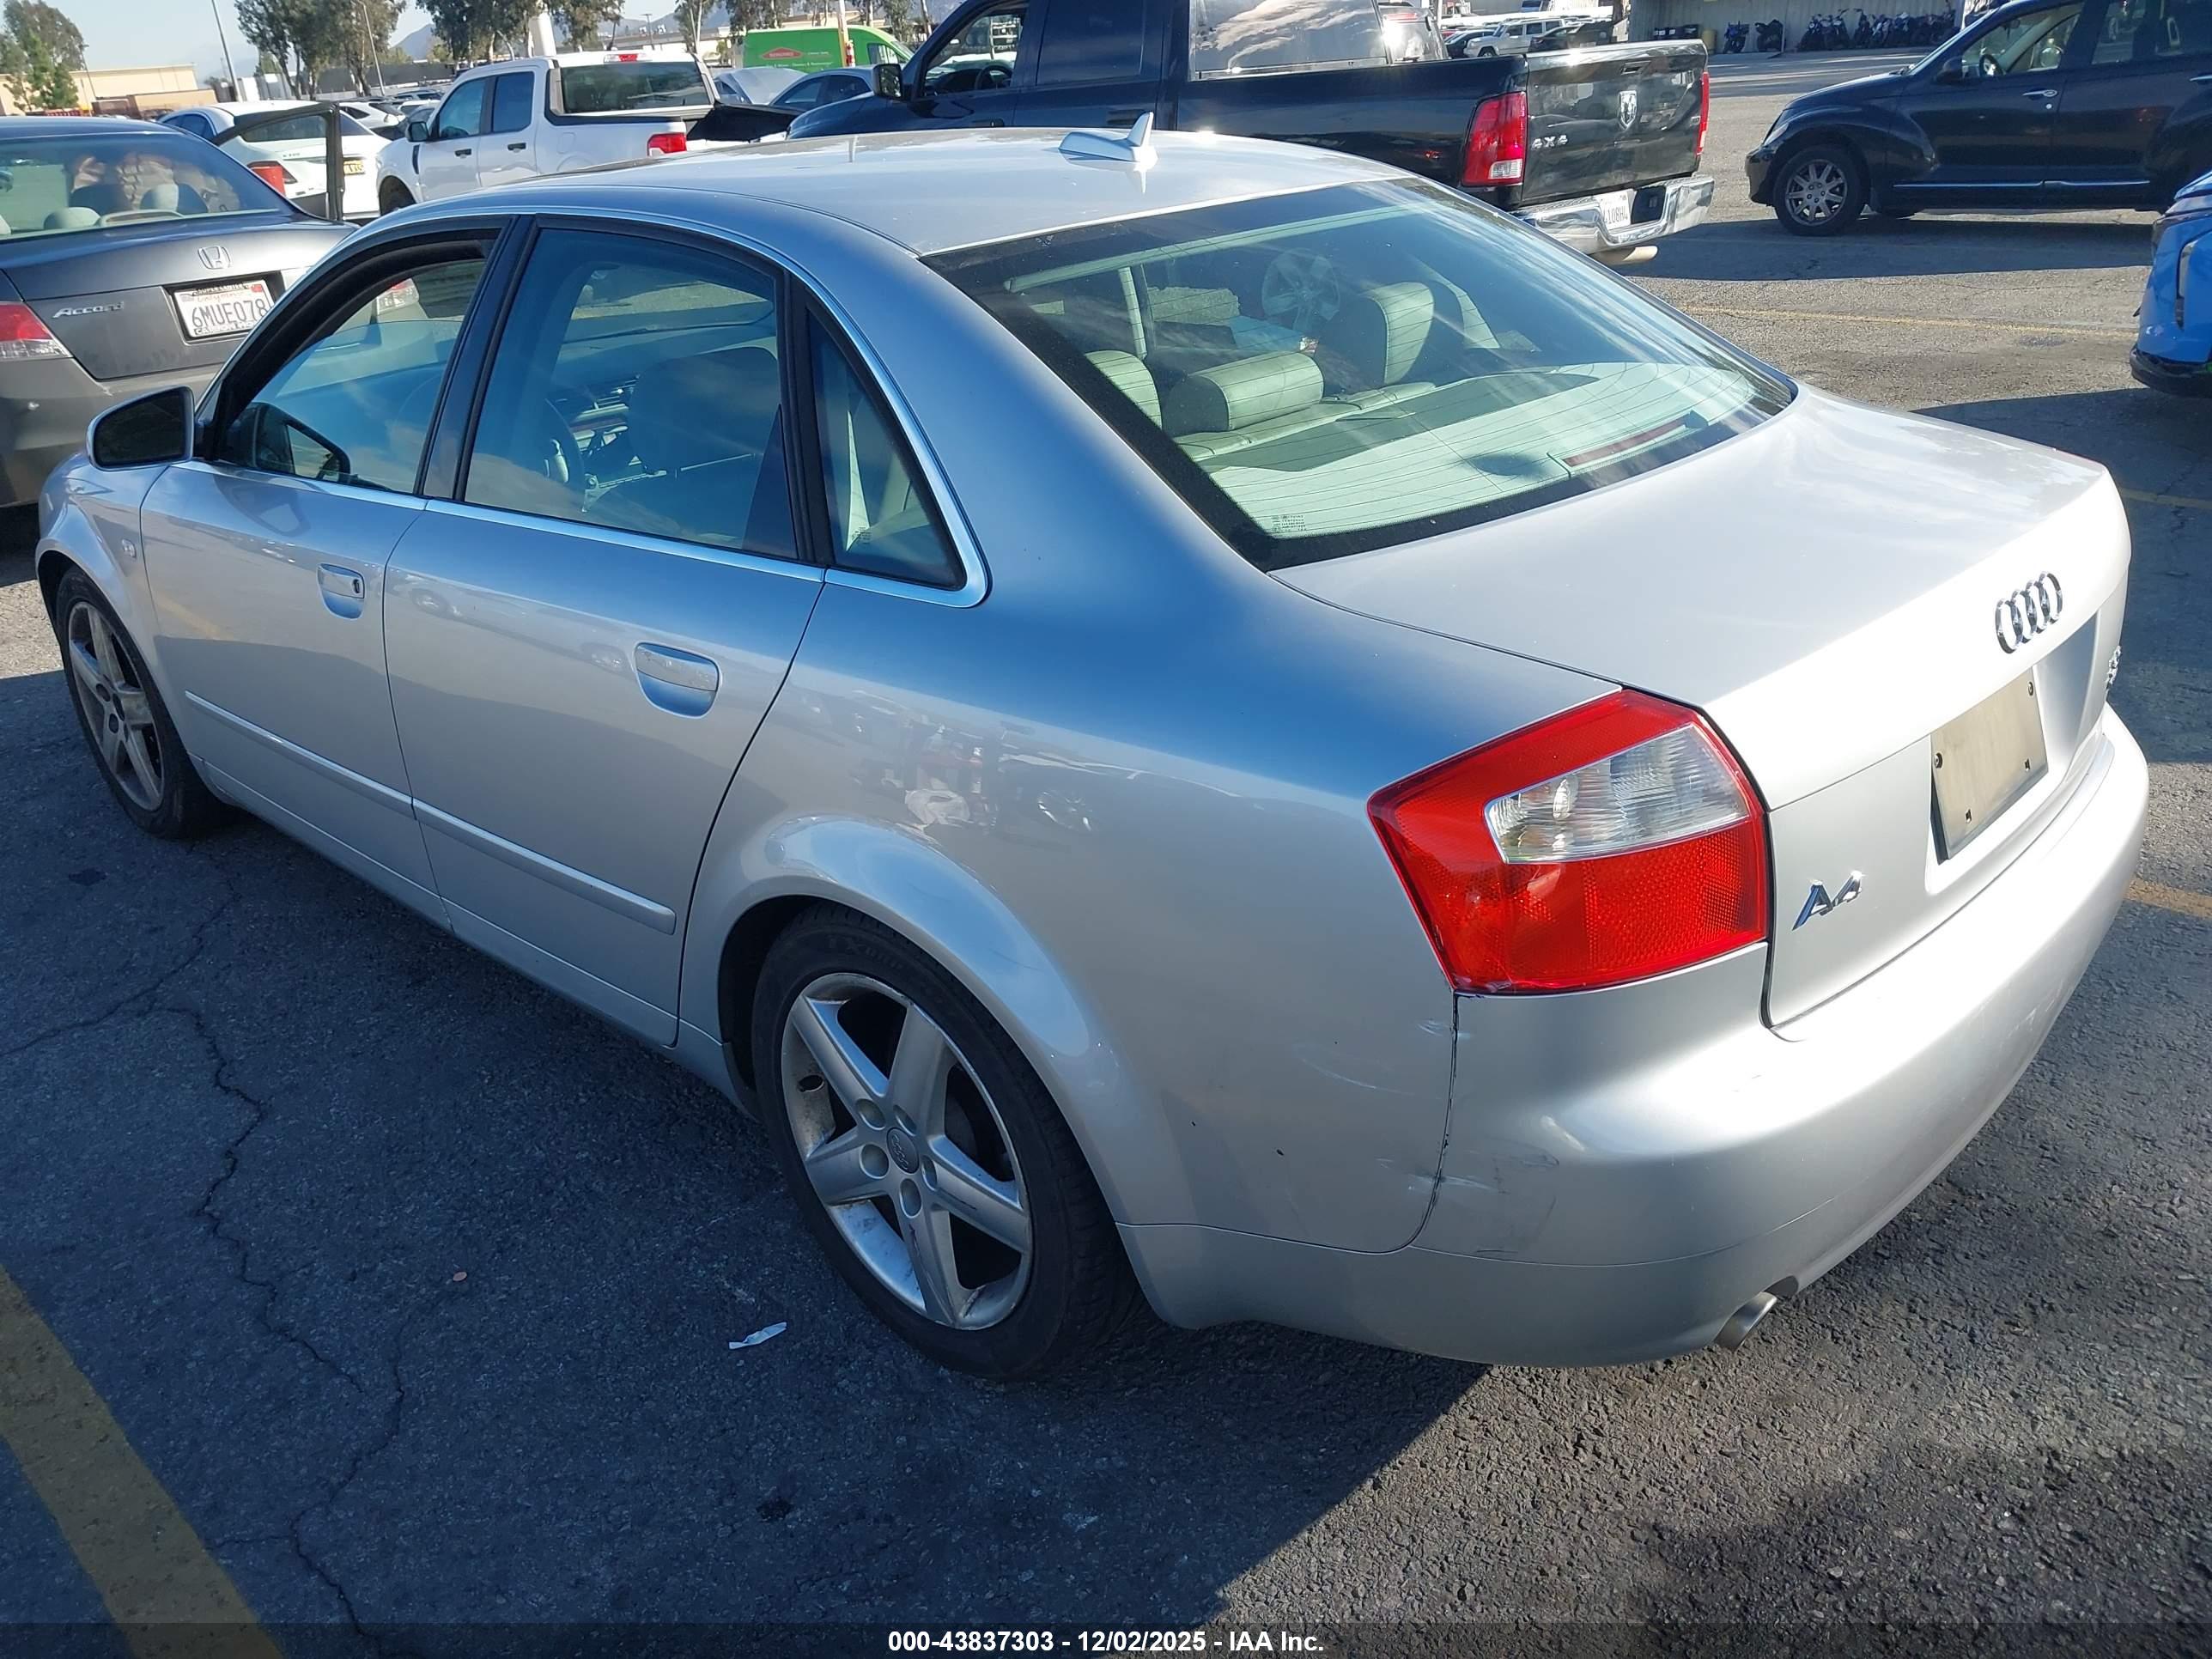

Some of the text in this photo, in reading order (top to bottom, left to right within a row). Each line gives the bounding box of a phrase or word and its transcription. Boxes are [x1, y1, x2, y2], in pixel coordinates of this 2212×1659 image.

[52, 301, 125, 318] Accord
[191, 298, 268, 327] 6MUE078
[1791, 870, 1863, 932] A4
